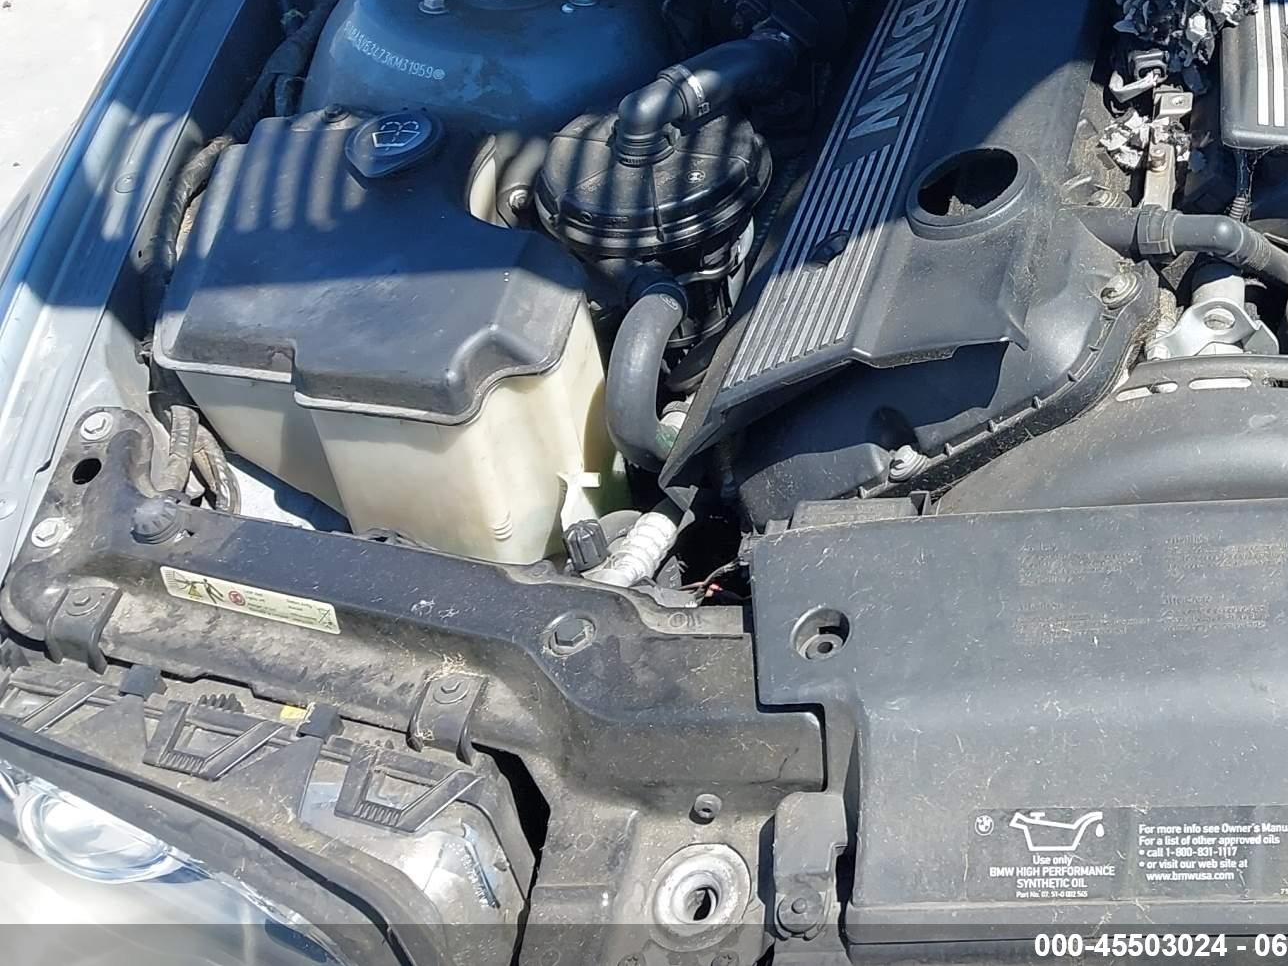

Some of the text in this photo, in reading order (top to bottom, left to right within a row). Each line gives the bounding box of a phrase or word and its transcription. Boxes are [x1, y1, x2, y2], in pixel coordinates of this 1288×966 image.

[1139, 824, 1155, 834] For
[1157, 826, 1181, 834] more
[1183, 824, 1202, 834] info
[1203, 825, 1220, 833] see
[1221, 823, 1260, 833] Owner's
[1139, 836, 1155, 846] For
[1165, 835, 1179, 845] list
[1181, 835, 1191, 845] of
[1192, 835, 1217, 845] other
[1218, 835, 1261, 846] approved
[1263, 835, 1280, 844] oils
[1146, 846, 1237, 857] call 1-800-831-1117
[1032, 854, 1073, 866] Use only
[1146, 858, 1248, 869] or visit our web site at
[989, 866, 1116, 877] BMW HIGH PERFORMANCE
[1146, 871, 1235, 882] www.bmwusa.com
[1016, 878, 1088, 888] SYNTHETIC OIL
